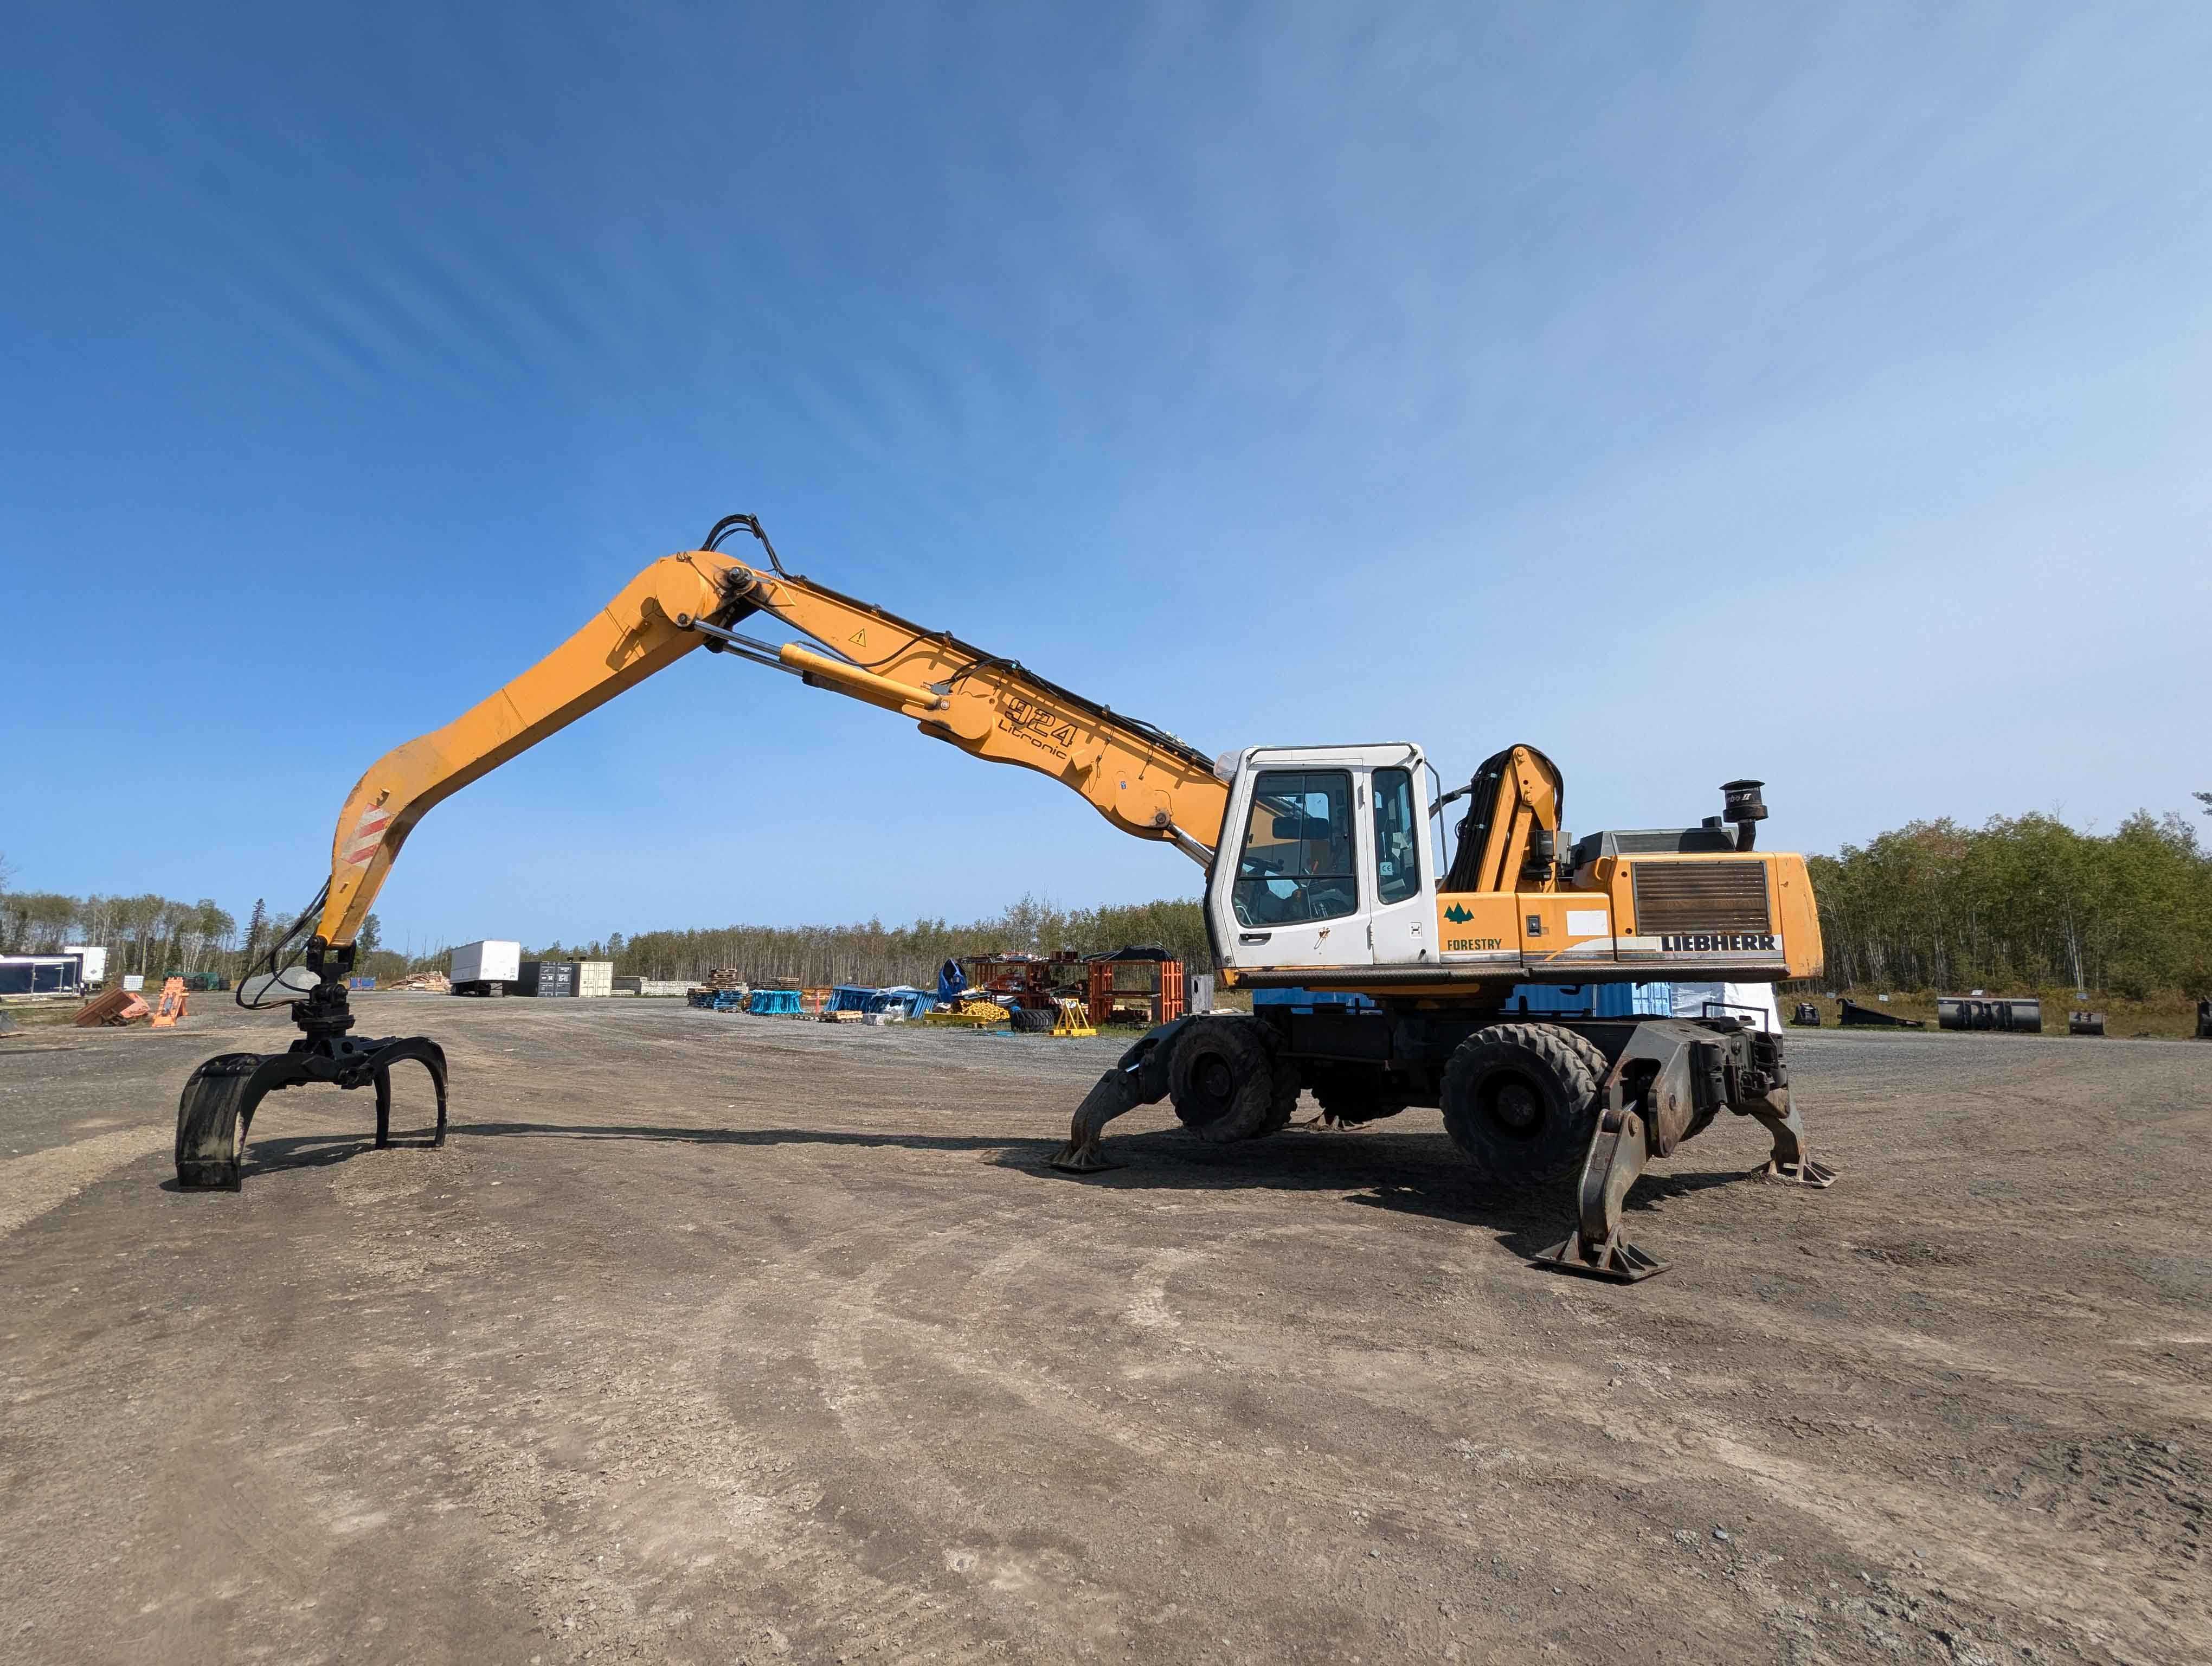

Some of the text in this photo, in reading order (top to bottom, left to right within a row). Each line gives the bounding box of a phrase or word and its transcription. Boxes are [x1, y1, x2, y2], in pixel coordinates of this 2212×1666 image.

[1004, 697, 1073, 747] 924
[998, 719, 1067, 759] Litronic
[1448, 938, 1502, 950] FORESTRY
[1661, 935, 1777, 951] LIEBHERR
